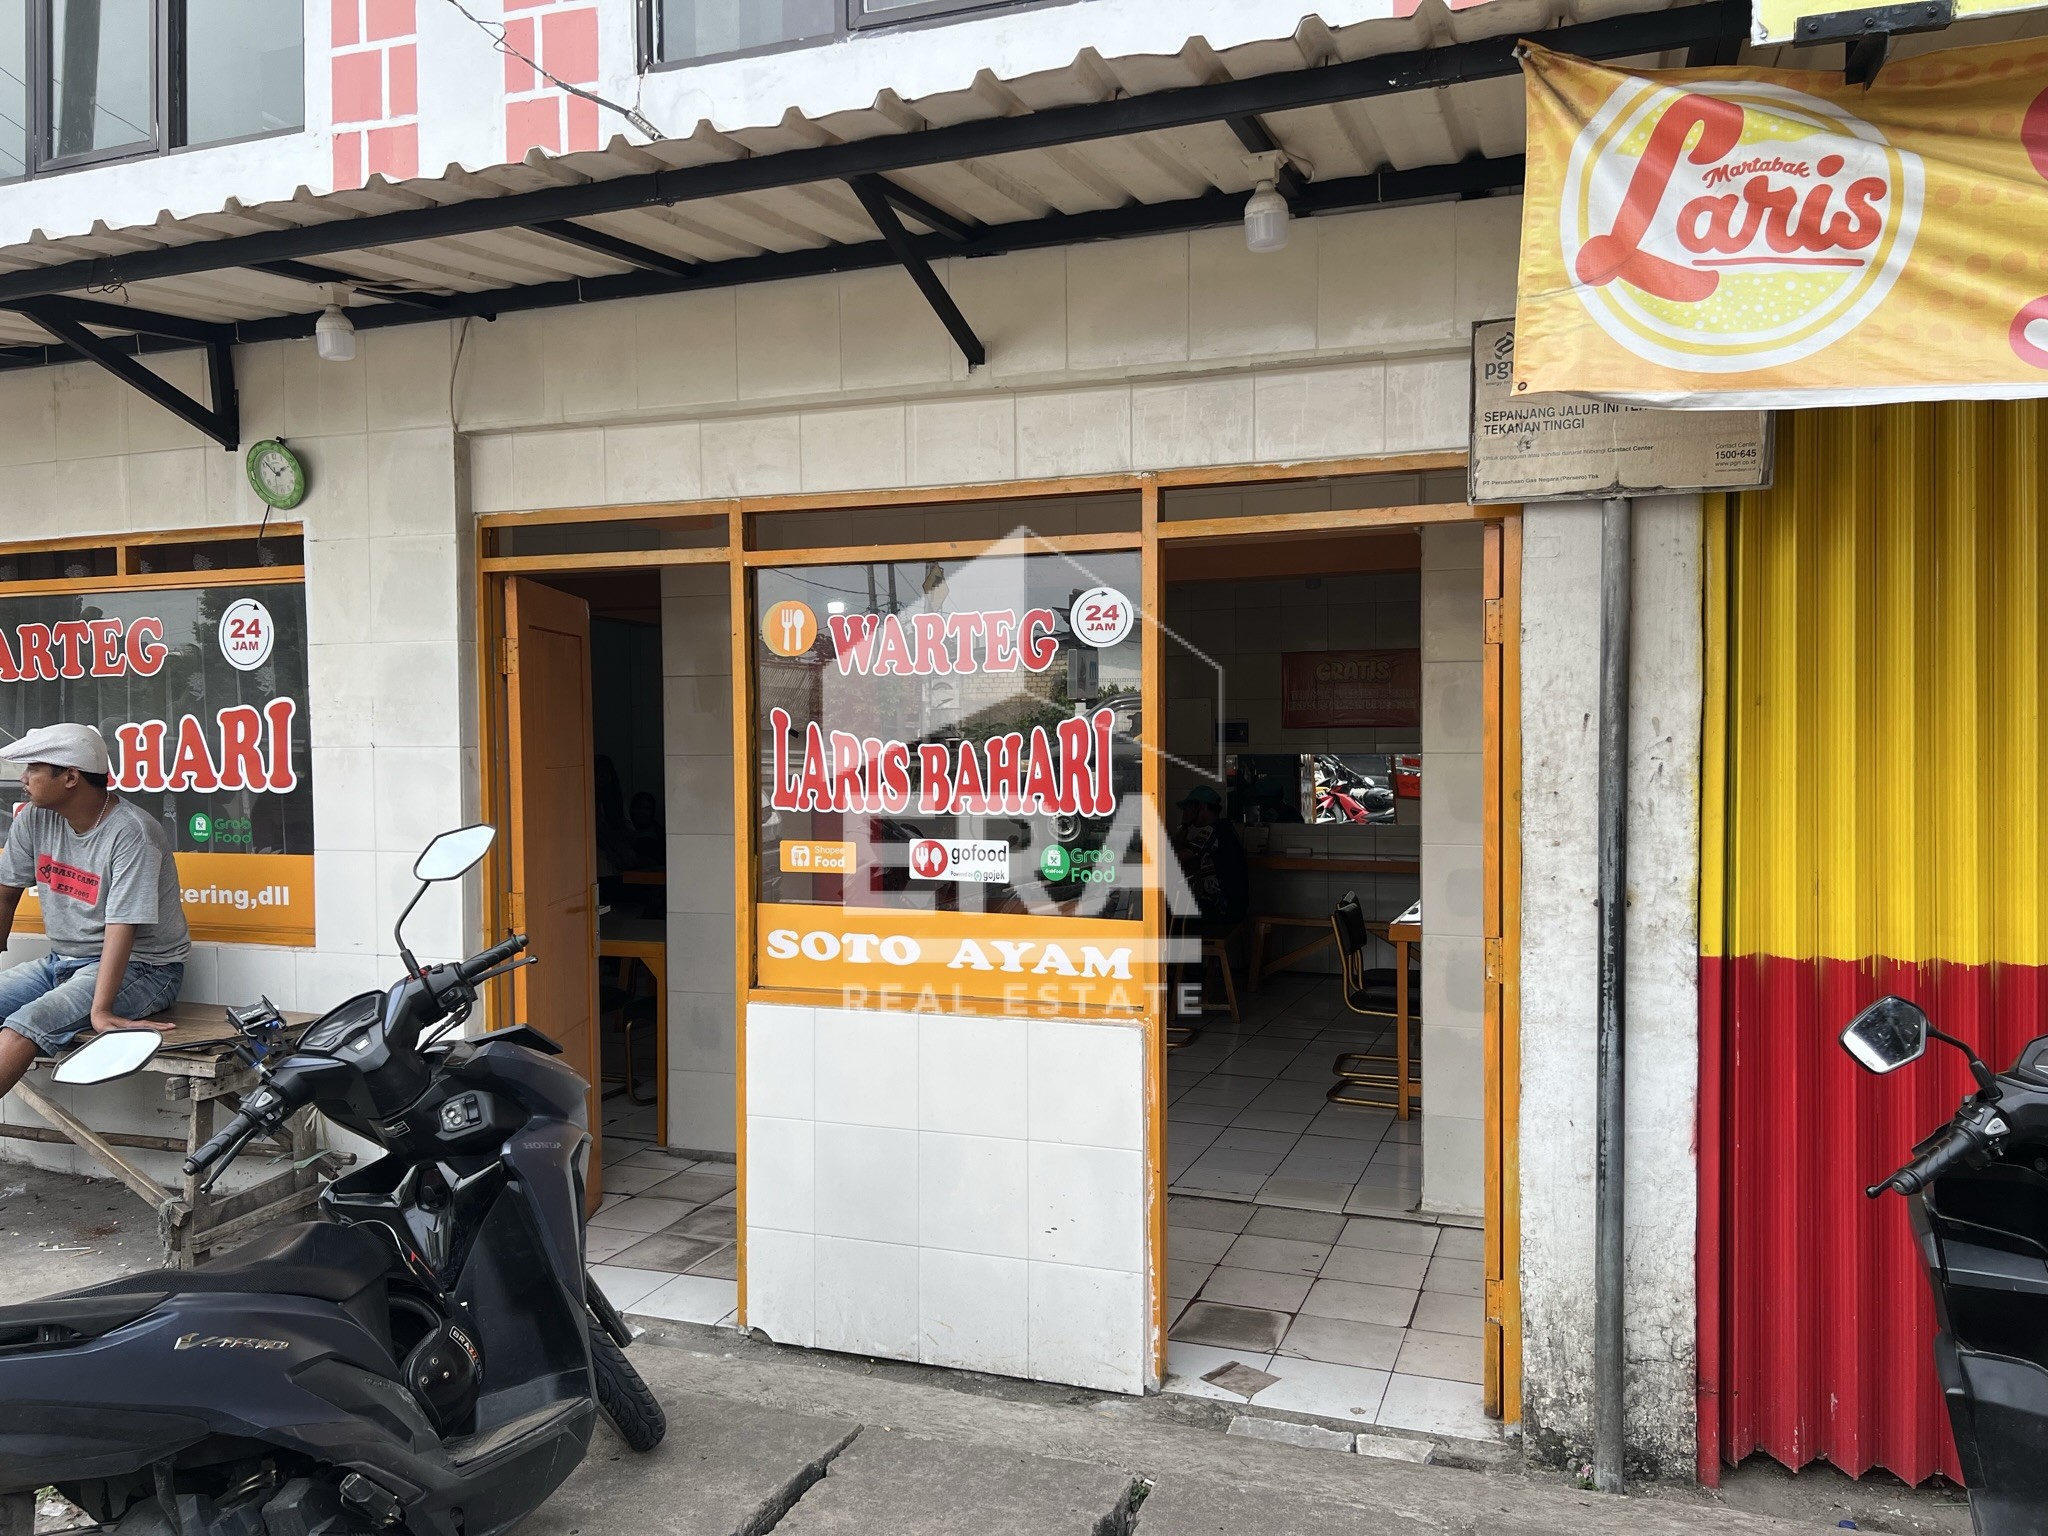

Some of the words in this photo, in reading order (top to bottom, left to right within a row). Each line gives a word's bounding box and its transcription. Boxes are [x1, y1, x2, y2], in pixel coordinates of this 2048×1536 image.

[1702, 157, 1810, 188] Martabak
[1575, 93, 1887, 302] Laris
[1484, 407, 1555, 423] SEPANJANG
[1558, 404, 1600, 417] JALUR
[1603, 403, 1619, 413] INI
[1484, 422, 1540, 435] TEKANAN
[1543, 418, 1585, 431] TINGGI
[1085, 604, 1119, 621] 24
[230, 618, 262, 639] 24
[1087, 623, 1116, 631] JAM
[232, 641, 259, 651] JAM
[827, 607, 1059, 677] WARTEG
[1316, 661, 1391, 682] GRATIS
[107, 696, 297, 794] HARI
[769, 707, 910, 814] LARIS
[917, 707, 1116, 817] BAHARI
[214, 817, 252, 830] Grab
[214, 831, 253, 843] Food
[814, 846, 845, 856] Shopee
[951, 844, 1007, 865] gofood
[1070, 844, 1115, 864] Grab
[814, 856, 846, 868] Food
[983, 870, 1005, 881] gojek
[1071, 865, 1115, 883] Food
[57, 883, 74, 893] EST
[766, 929, 921, 966] SOTO
[946, 938, 1133, 980] AYAM
